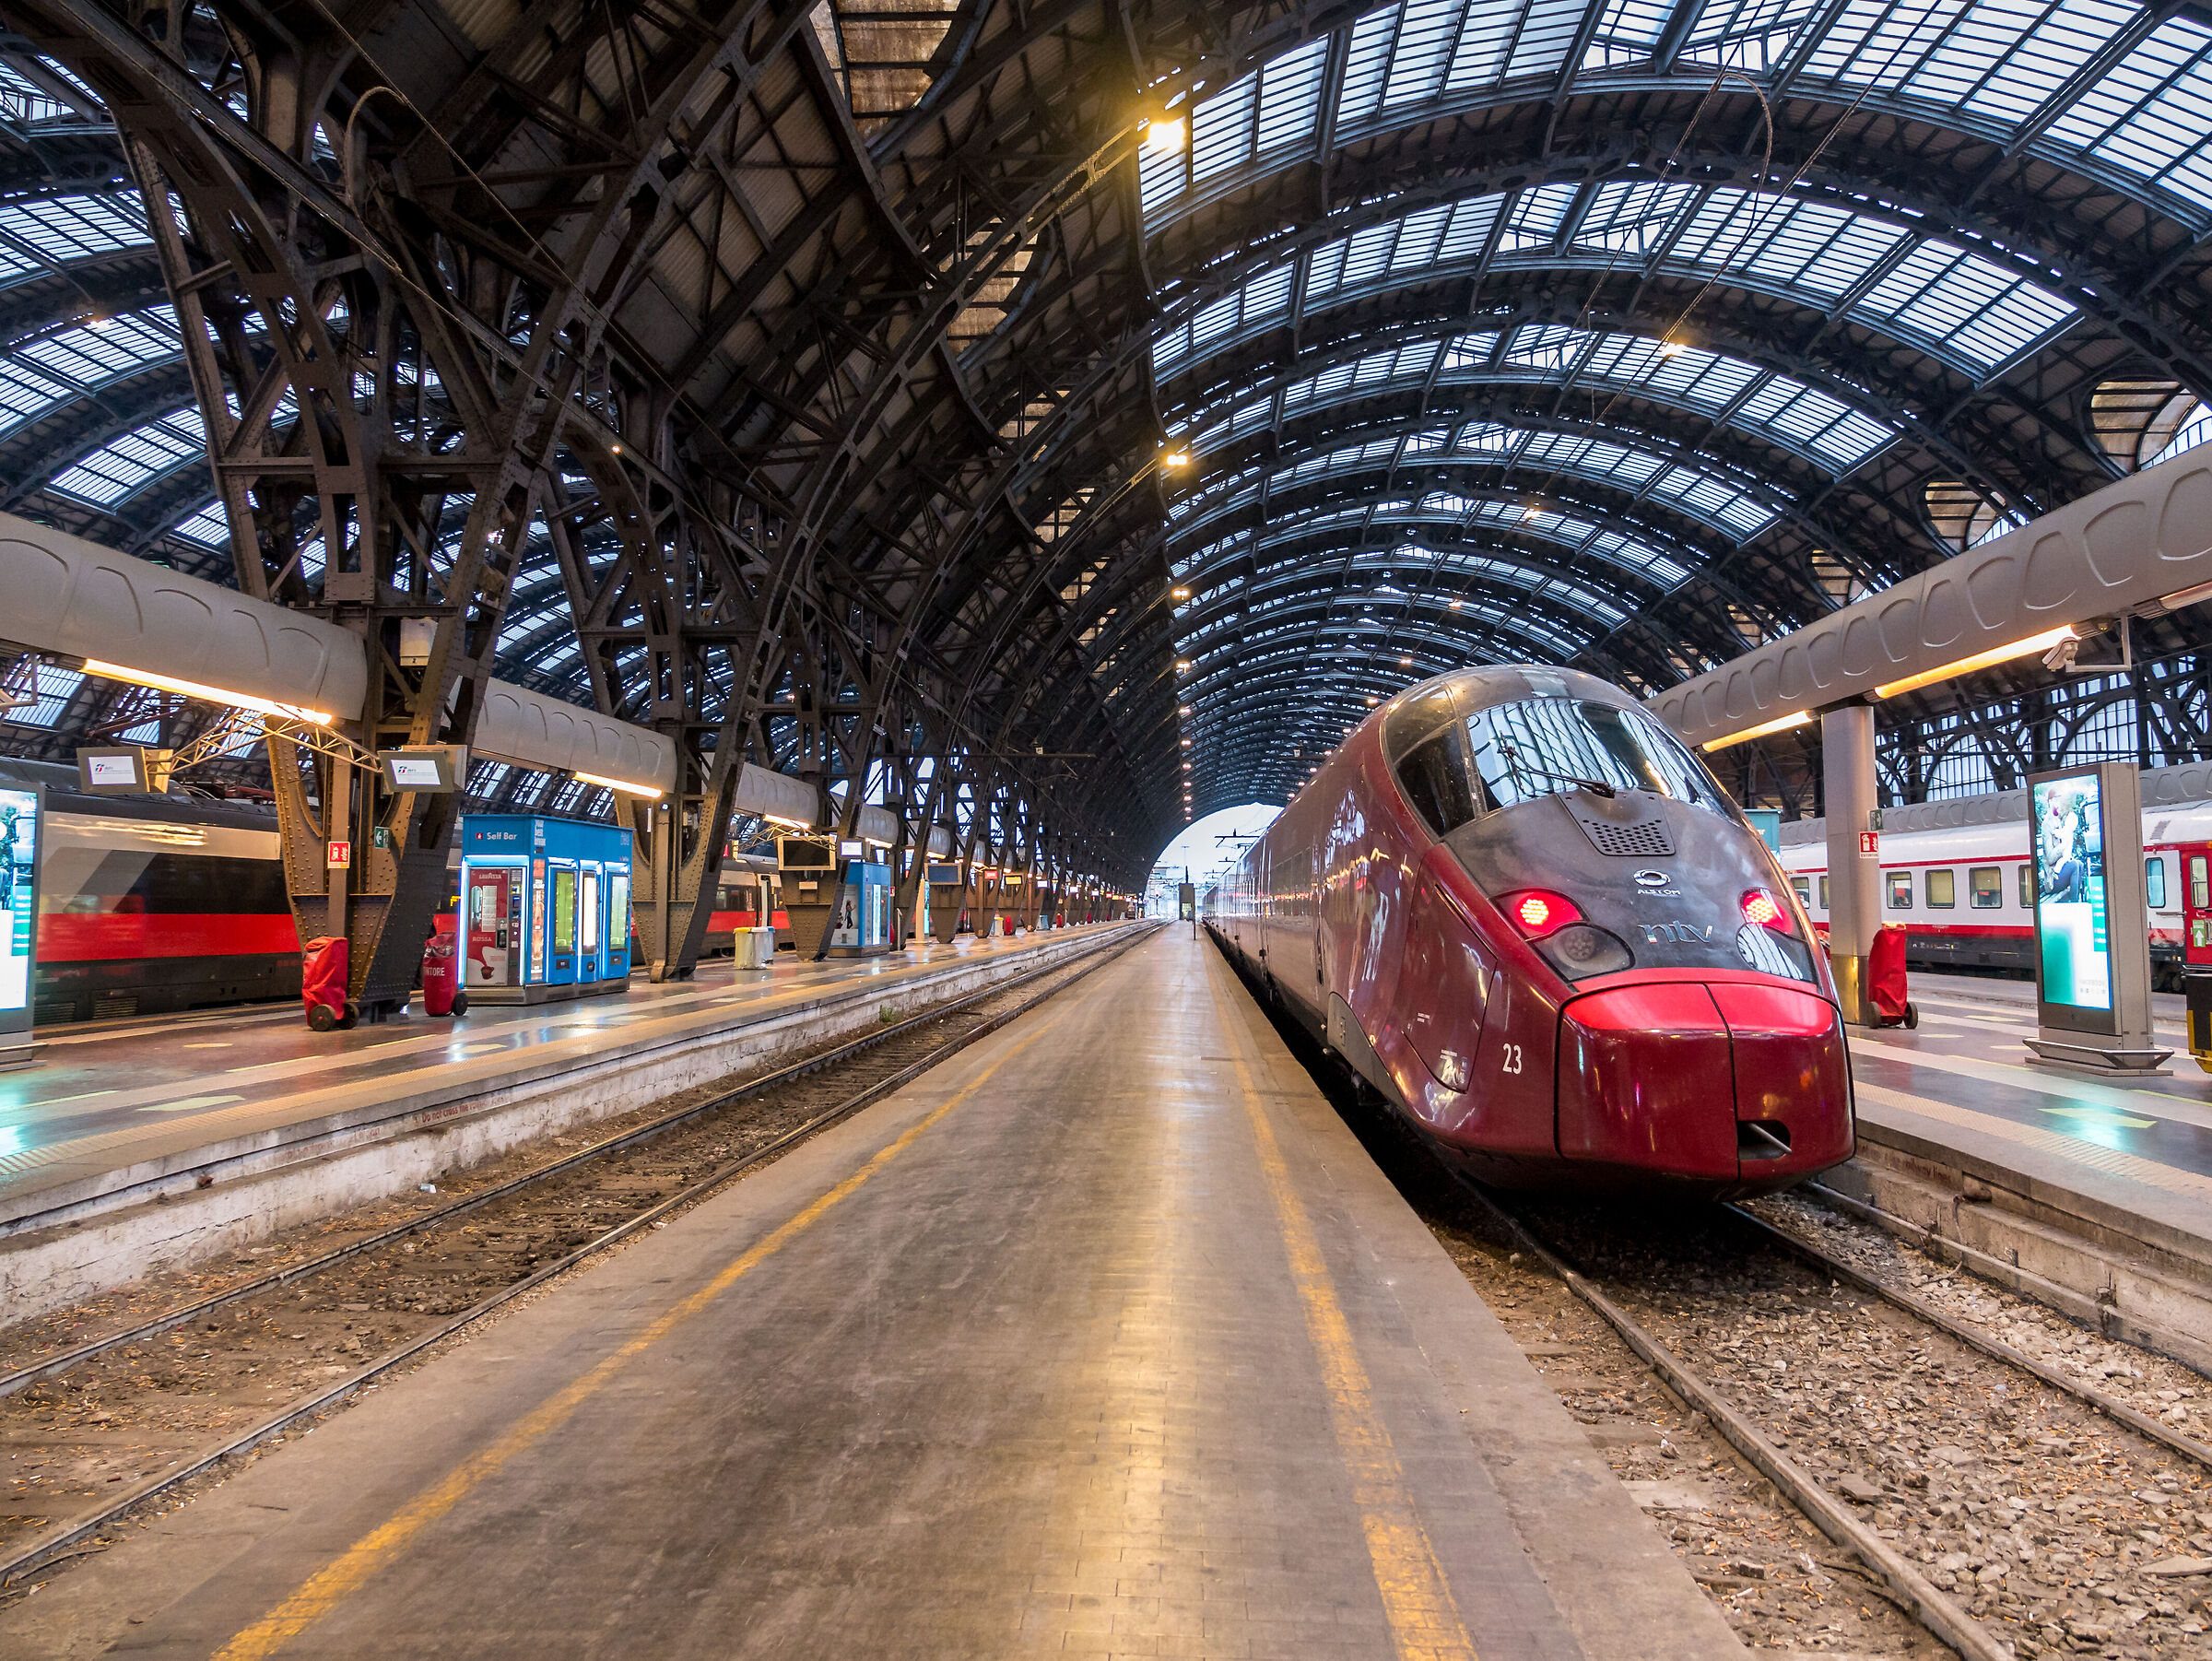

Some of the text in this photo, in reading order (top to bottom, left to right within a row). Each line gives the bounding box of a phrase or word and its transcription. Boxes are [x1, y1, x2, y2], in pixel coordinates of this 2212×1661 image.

[487, 831, 518, 841] Self Bar
[1637, 920, 1713, 943] ntv
[1502, 1043, 1523, 1075] 23
